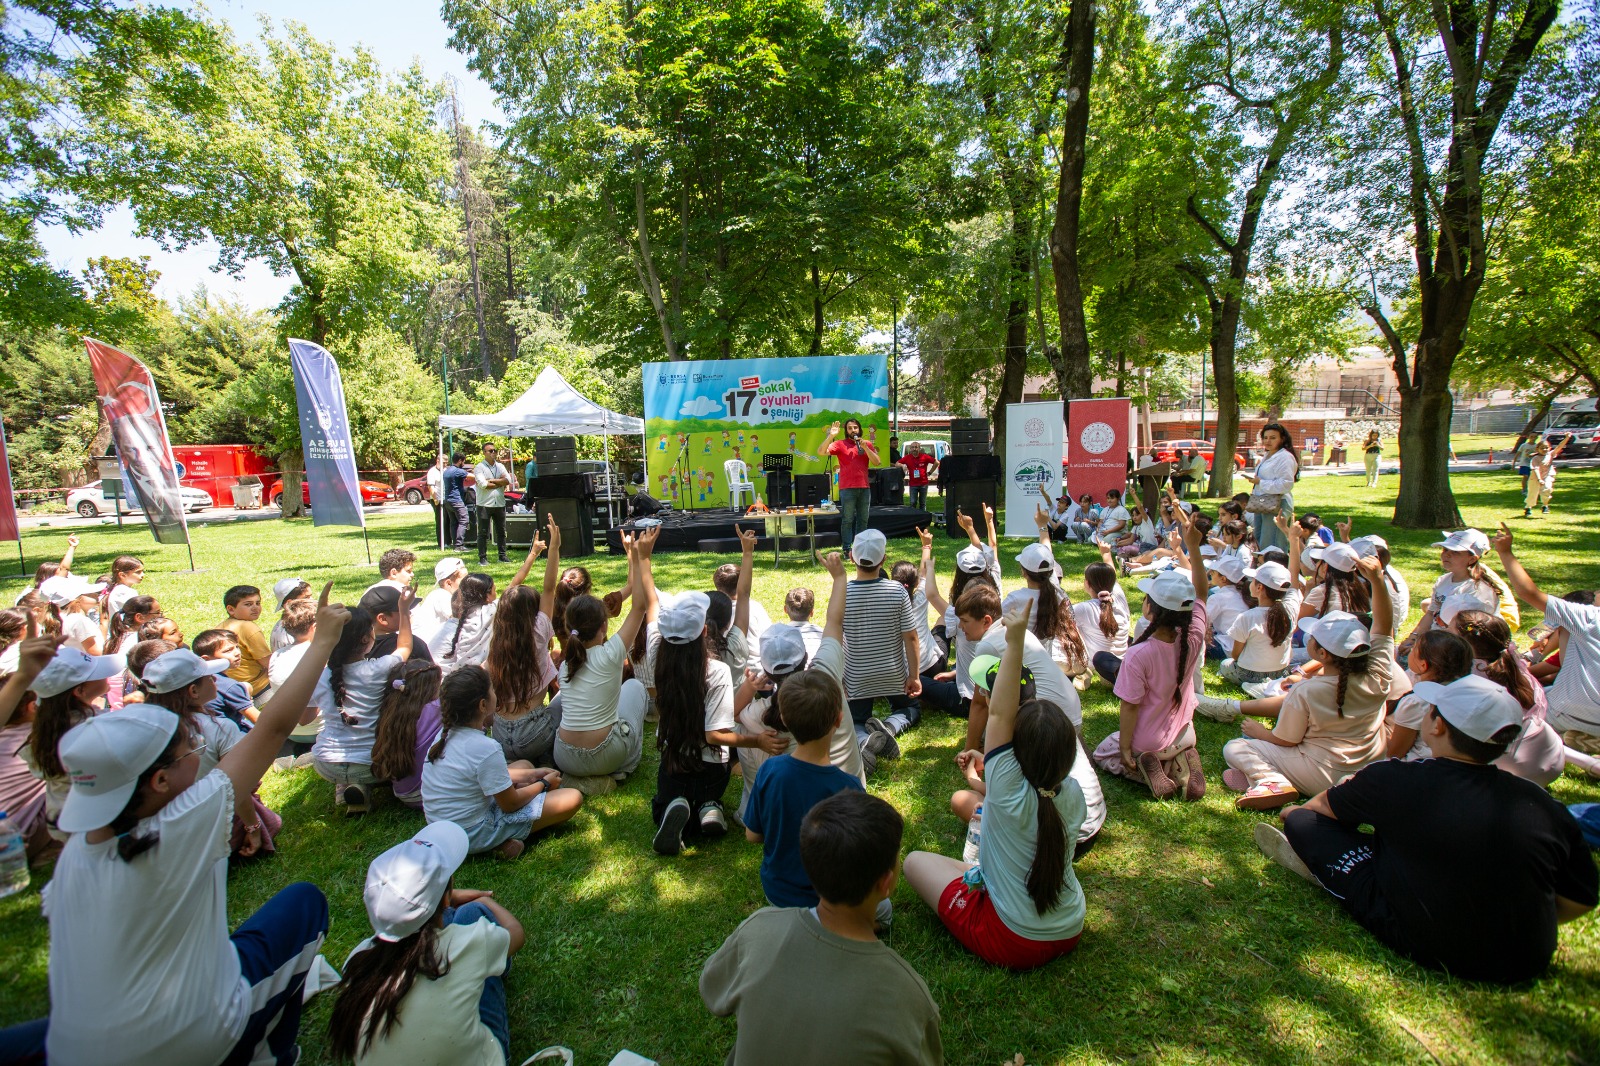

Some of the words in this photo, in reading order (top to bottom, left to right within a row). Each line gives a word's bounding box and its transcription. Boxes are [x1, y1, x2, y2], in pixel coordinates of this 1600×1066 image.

[758, 381, 793, 396] sokak
[760, 394, 810, 407] oyunları
[770, 408, 804, 421] şenliği
[1306, 438, 1317, 450] WC
